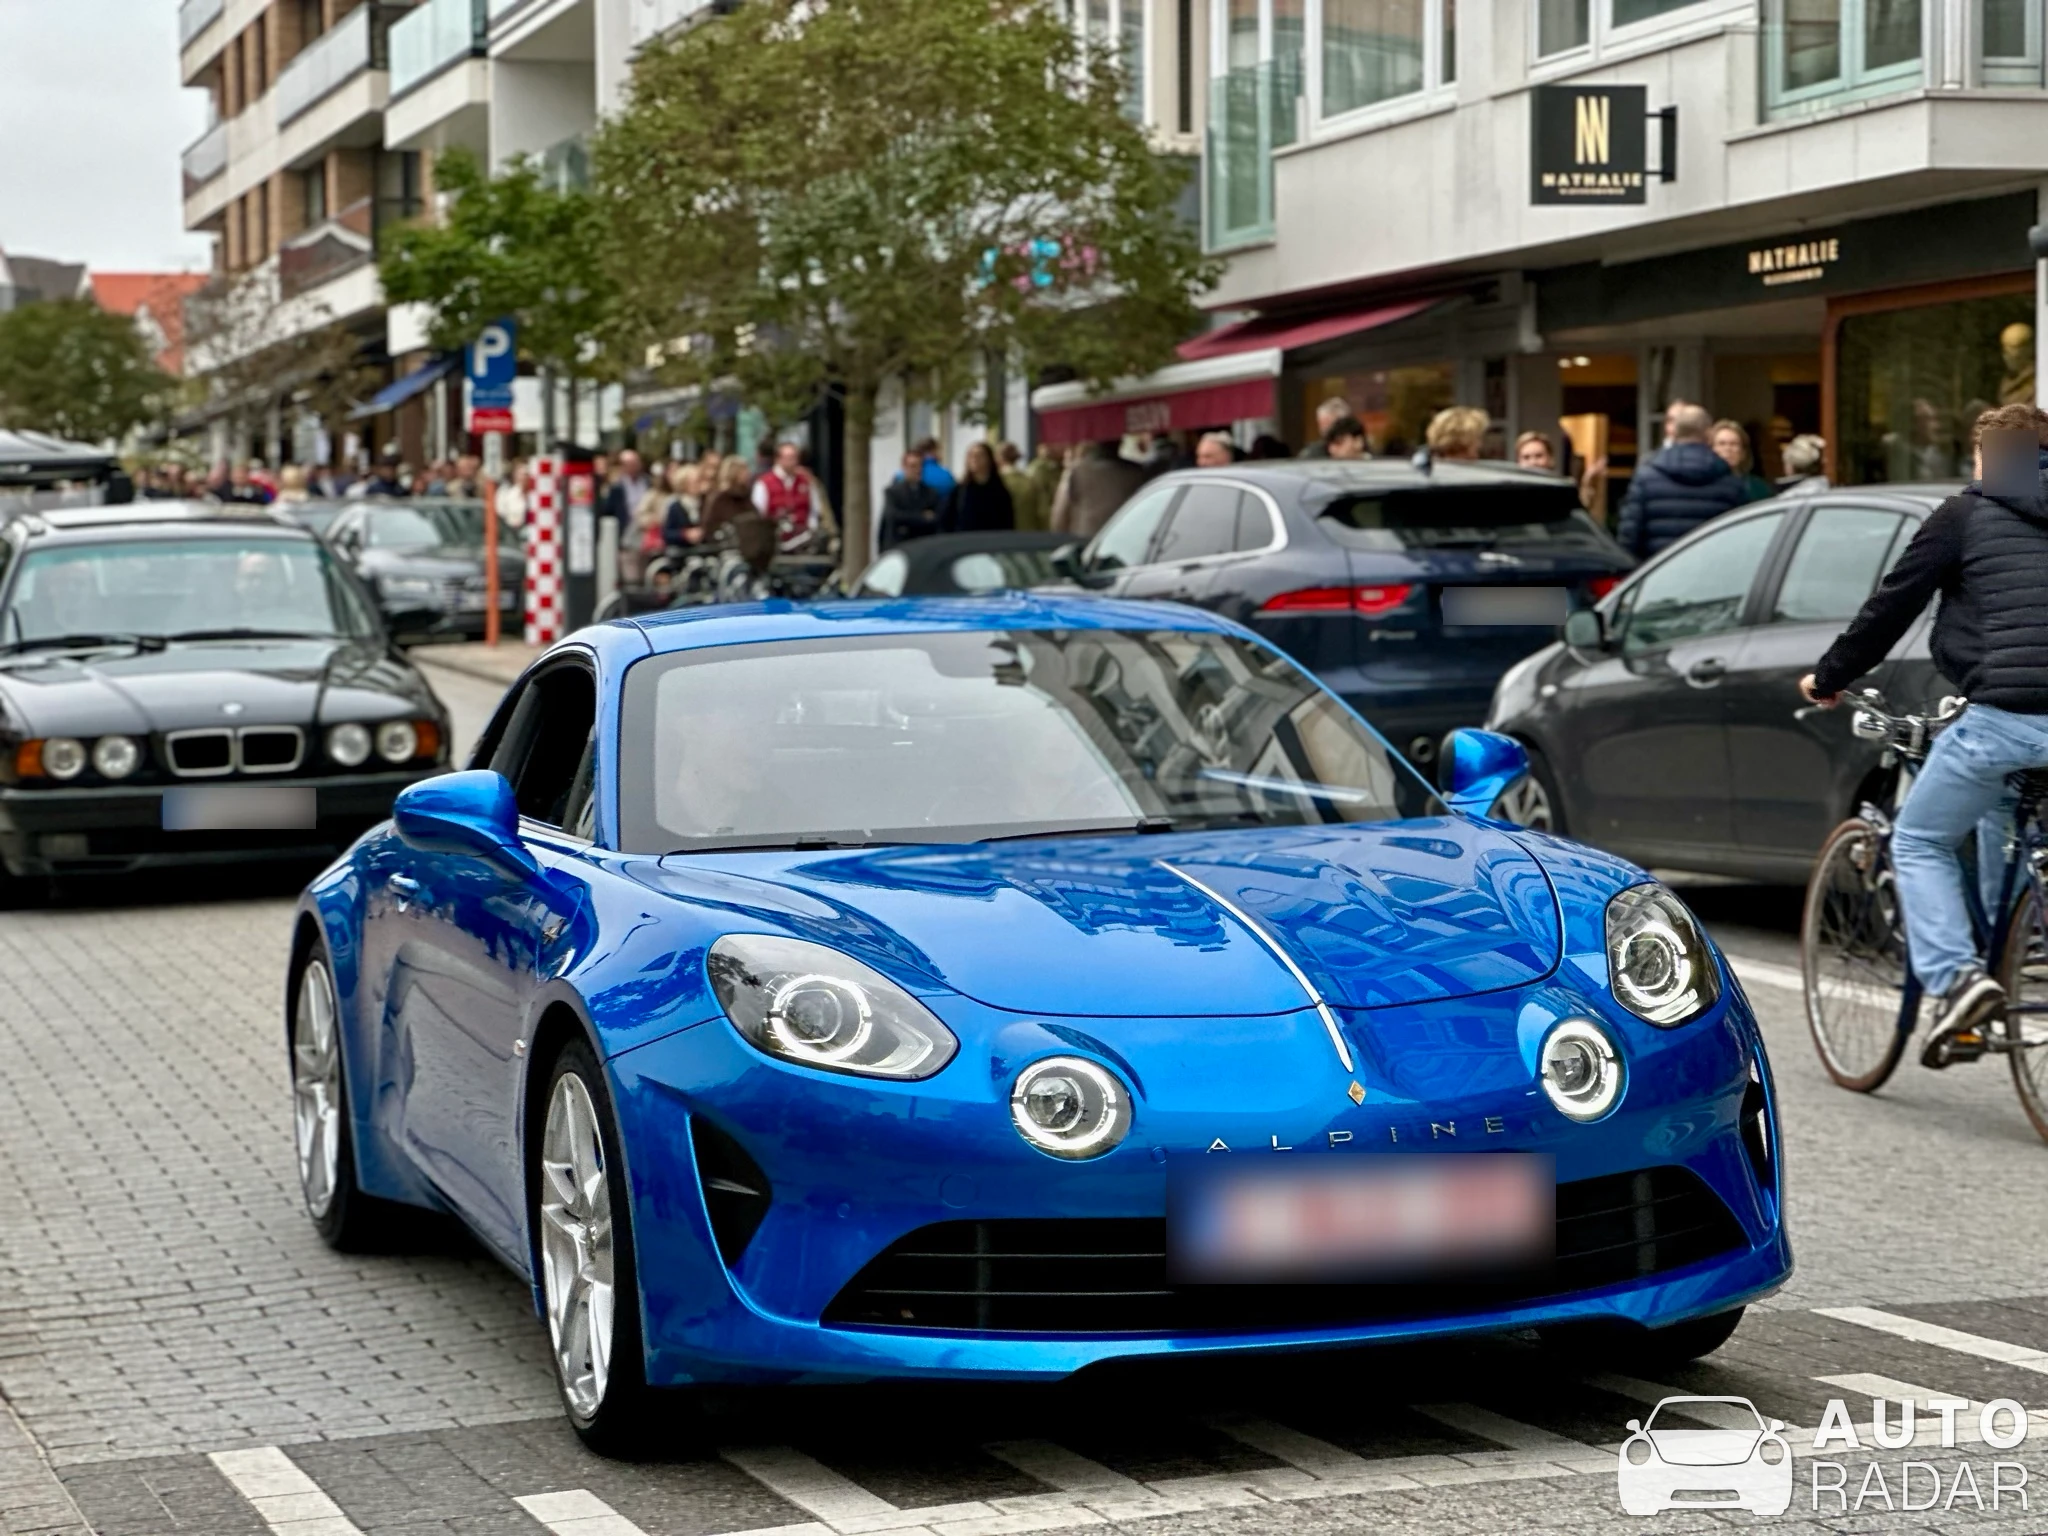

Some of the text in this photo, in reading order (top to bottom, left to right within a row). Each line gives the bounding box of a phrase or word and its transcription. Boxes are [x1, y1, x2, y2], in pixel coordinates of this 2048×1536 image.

[1542, 173, 1642, 187] NATHALIE
[1748, 238, 1839, 274] NATHALIE
[474, 326, 511, 376] P
[1206, 1115, 1506, 1154] ALPINE
